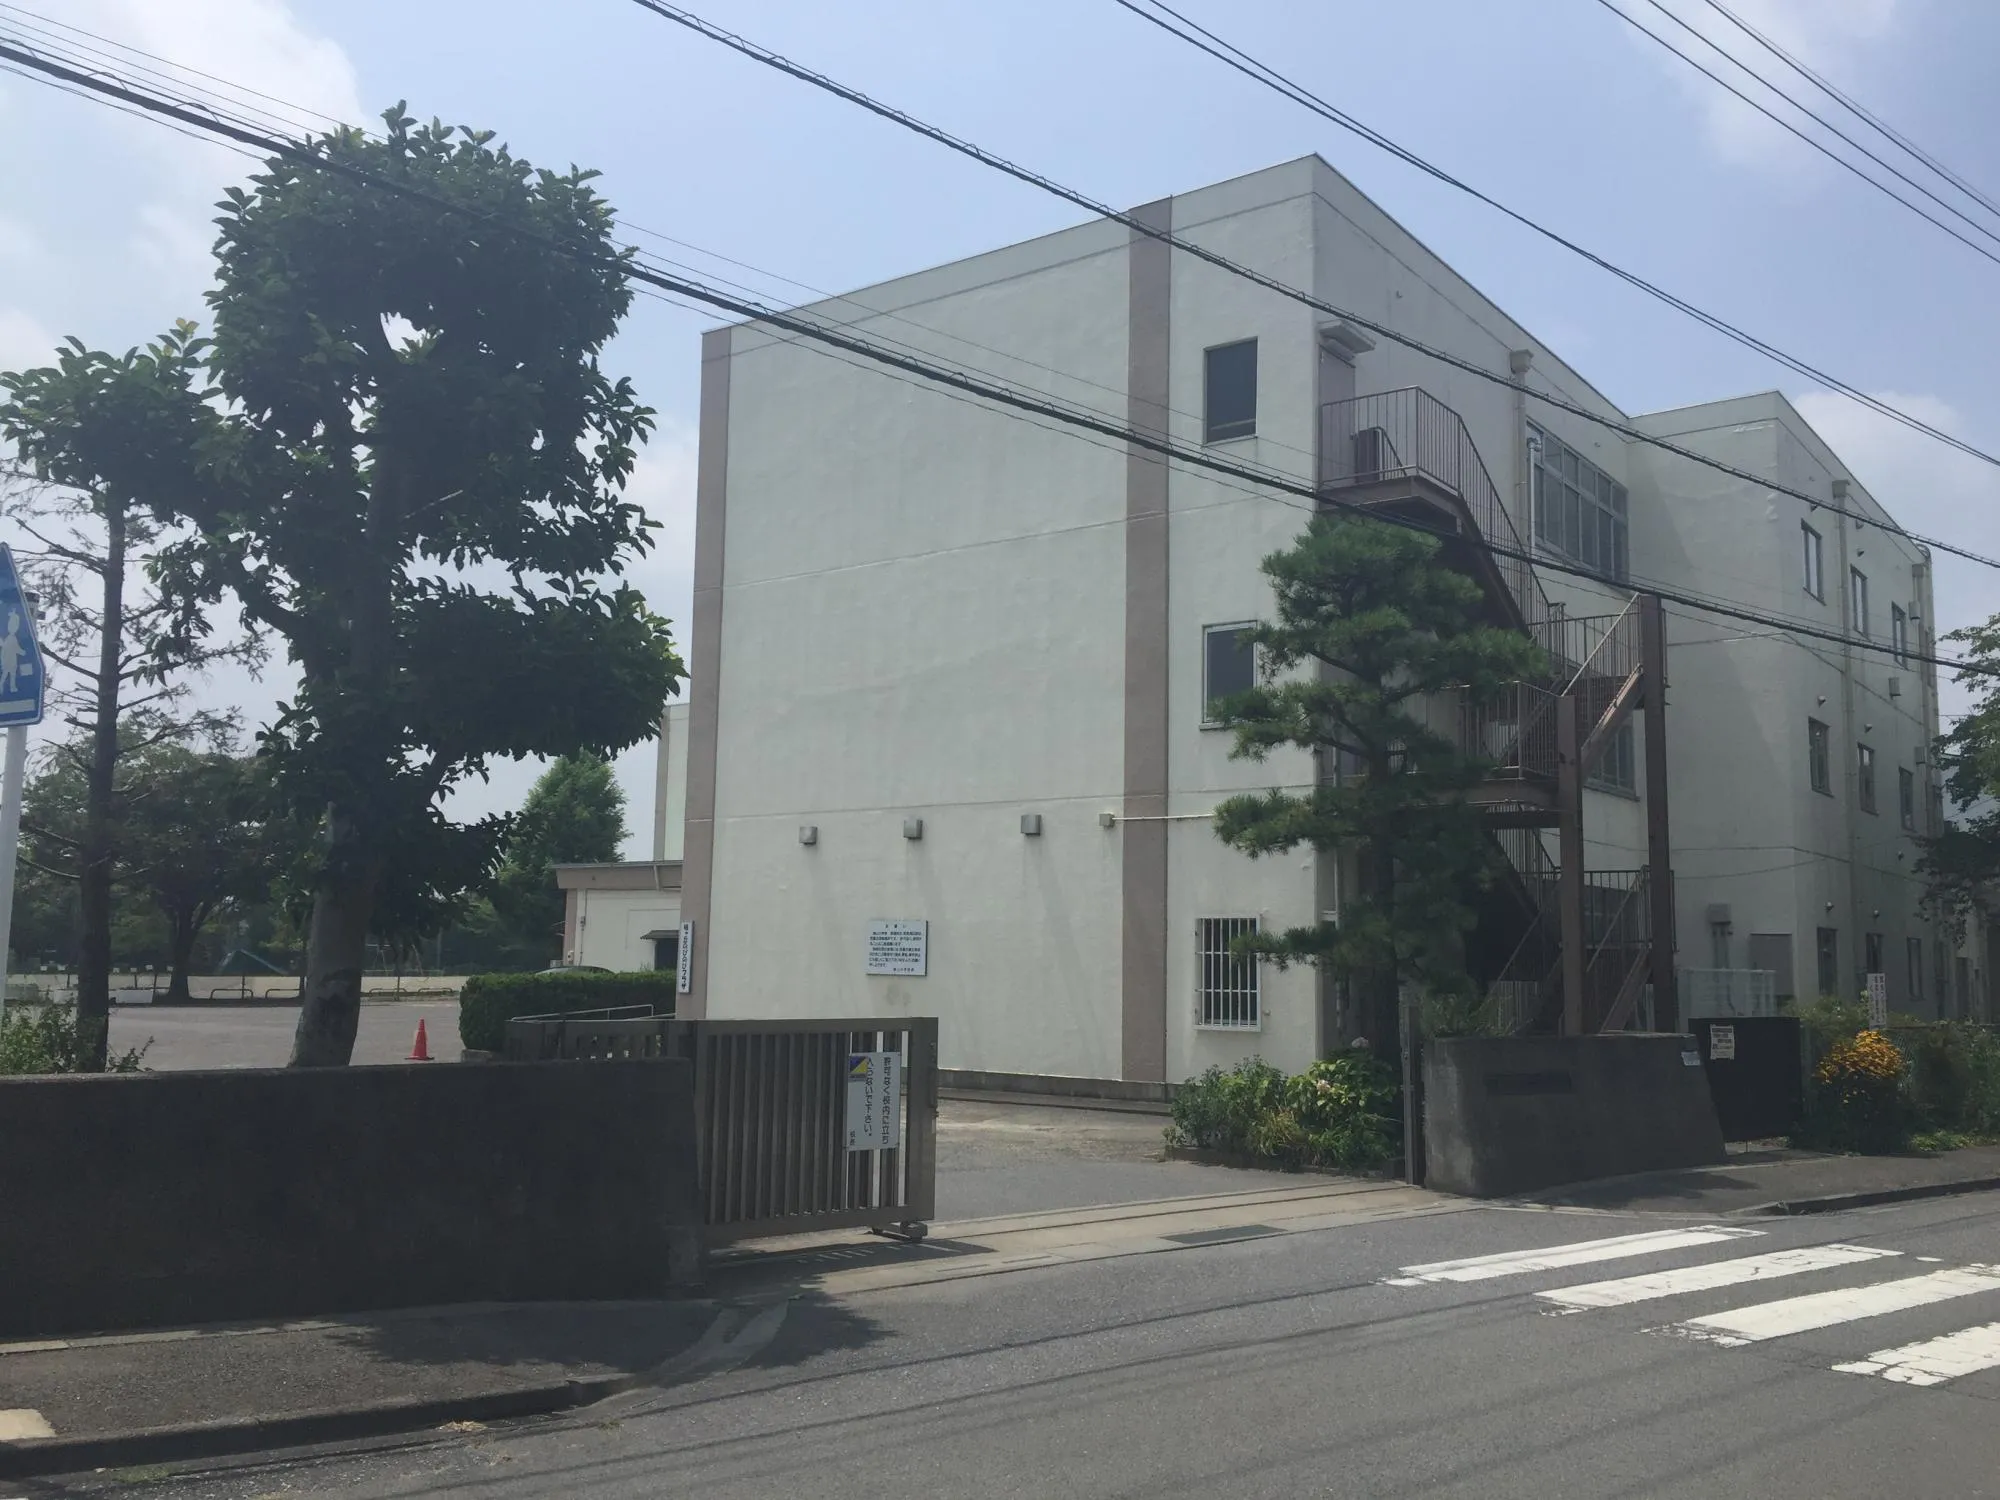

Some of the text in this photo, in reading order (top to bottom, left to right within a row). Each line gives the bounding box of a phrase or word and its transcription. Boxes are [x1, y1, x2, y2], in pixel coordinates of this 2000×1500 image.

[864, 1057, 874, 1136] 入らないで下さい。
[881, 1057, 892, 1144] 許可なく校内に立ち
